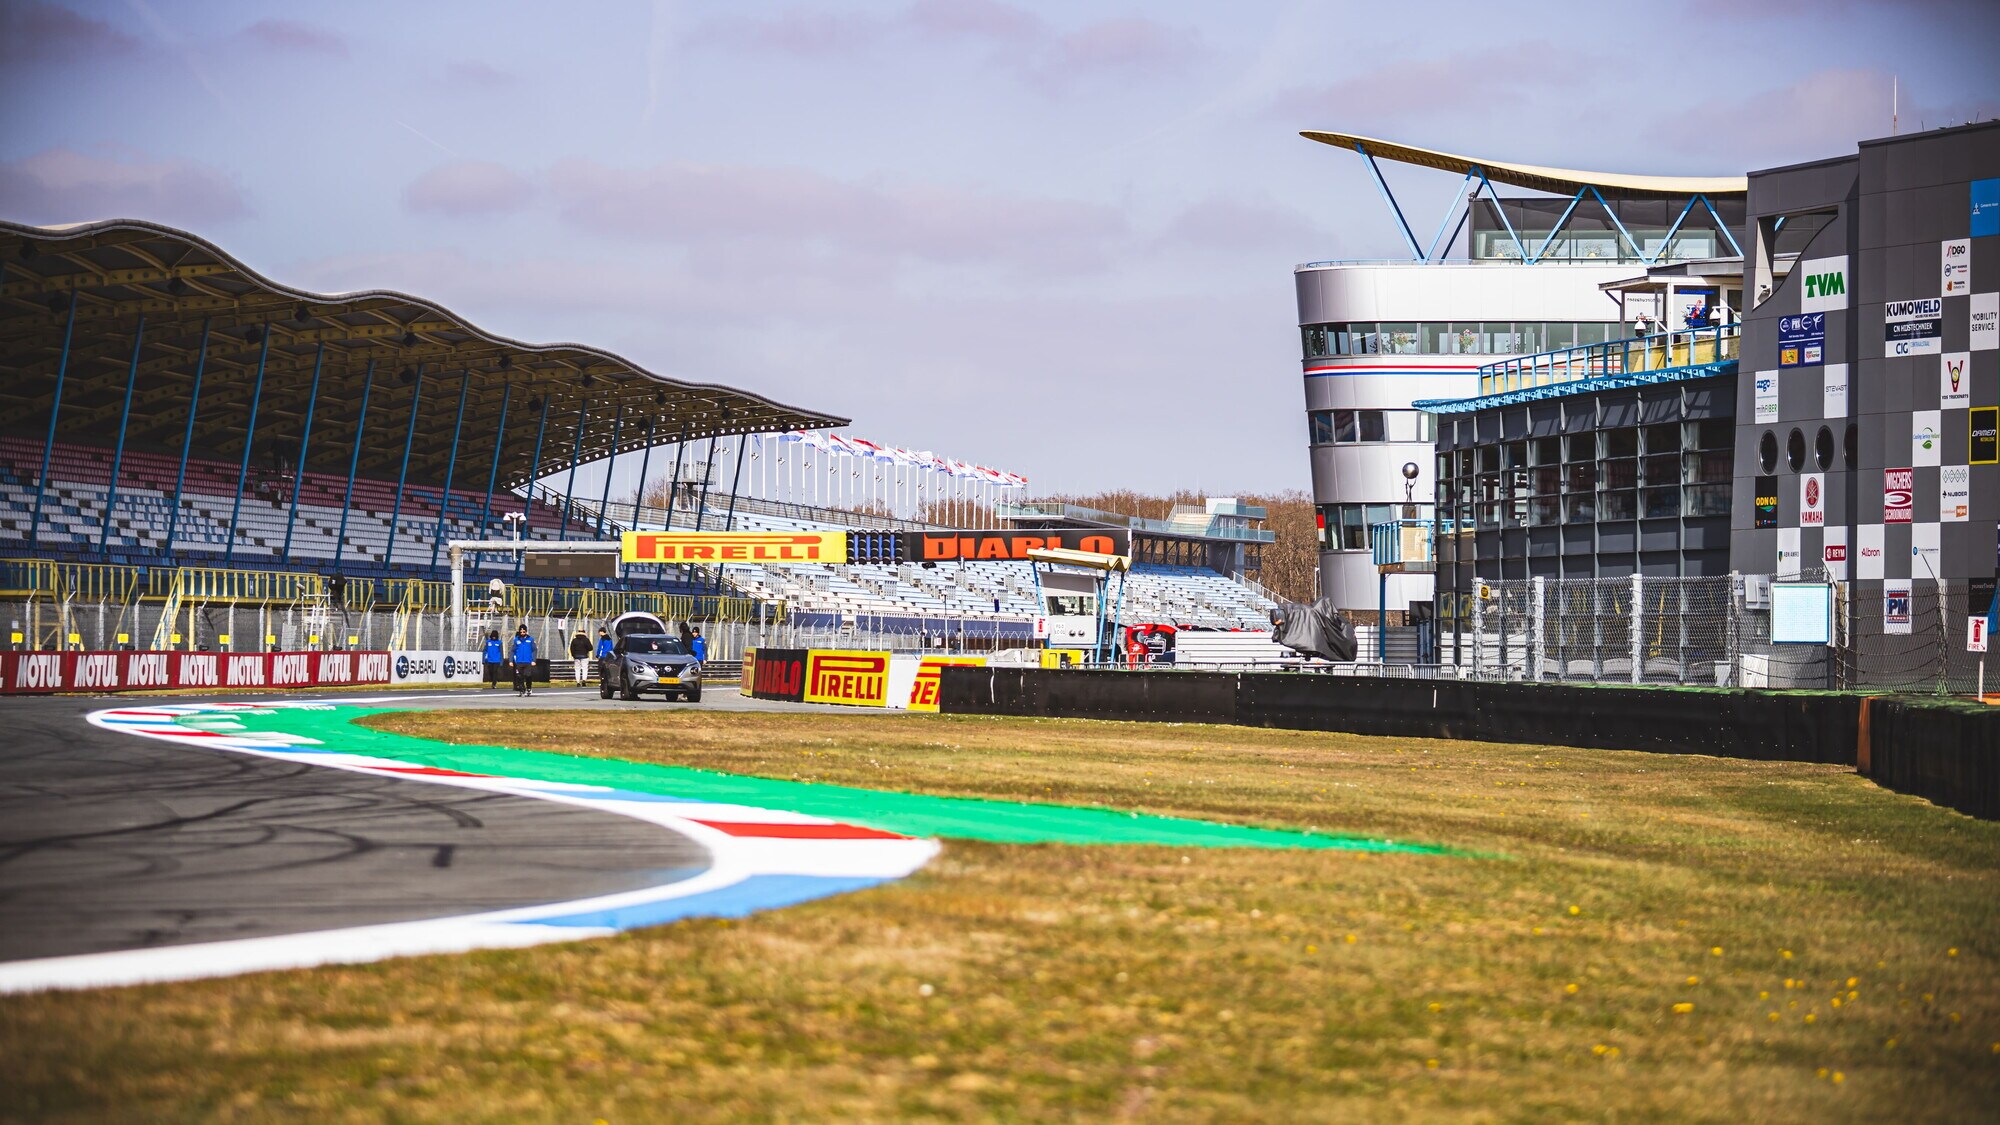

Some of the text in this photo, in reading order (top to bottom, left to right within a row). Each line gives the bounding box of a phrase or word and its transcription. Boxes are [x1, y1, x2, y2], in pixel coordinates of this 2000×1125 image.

[1805, 271, 1845, 298] TVM
[1886, 299, 1941, 317] KUMOWELD
[1972, 312, 1998, 321] MOBILITY
[1893, 324, 1900, 332] CN
[1896, 342, 1909, 354] CIG
[1885, 471, 1912, 490] WIGCHERS
[1755, 497, 1769, 506] ODN
[1801, 511, 1823, 523] YAMAHA
[636, 535, 822, 559] PIRELLI
[1861, 548, 1881, 557] Albron
[70, 574, 76, 590] K
[1889, 598, 1908, 615] PM
[16, 654, 62, 688] MOTUL
[74, 655, 118, 688] MOTUL
[127, 654, 169, 686] MOTUL
[179, 654, 218, 686] MOTUL
[227, 655, 265, 686] MOTUL
[272, 654, 309, 684] MOTUL
[318, 654, 351, 682] MOTUL
[357, 654, 389, 681] MOTUL
[410, 659, 436, 675] SUBARU
[455, 659, 480, 675] SUBARU
[754, 659, 802, 696] DIABLO
[810, 655, 885, 700] PIRELLI
